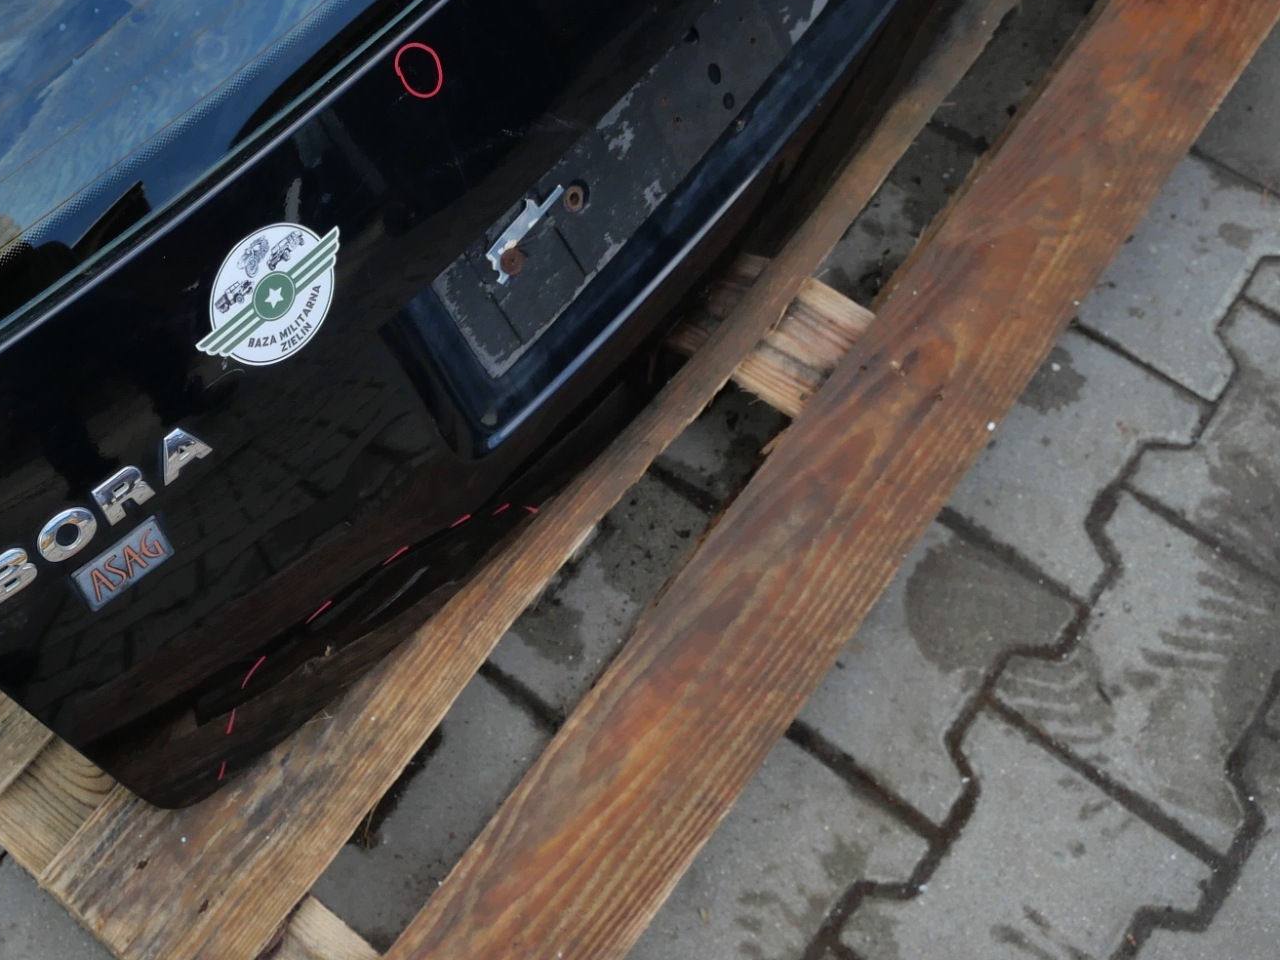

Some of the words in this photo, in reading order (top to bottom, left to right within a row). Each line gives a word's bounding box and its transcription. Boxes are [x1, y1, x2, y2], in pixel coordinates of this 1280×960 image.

[247, 335, 278, 349] BAZA
[279, 284, 322, 340] MILITARNA
[280, 322, 313, 353] ZIELIN
[89, 527, 165, 603] ASAG
